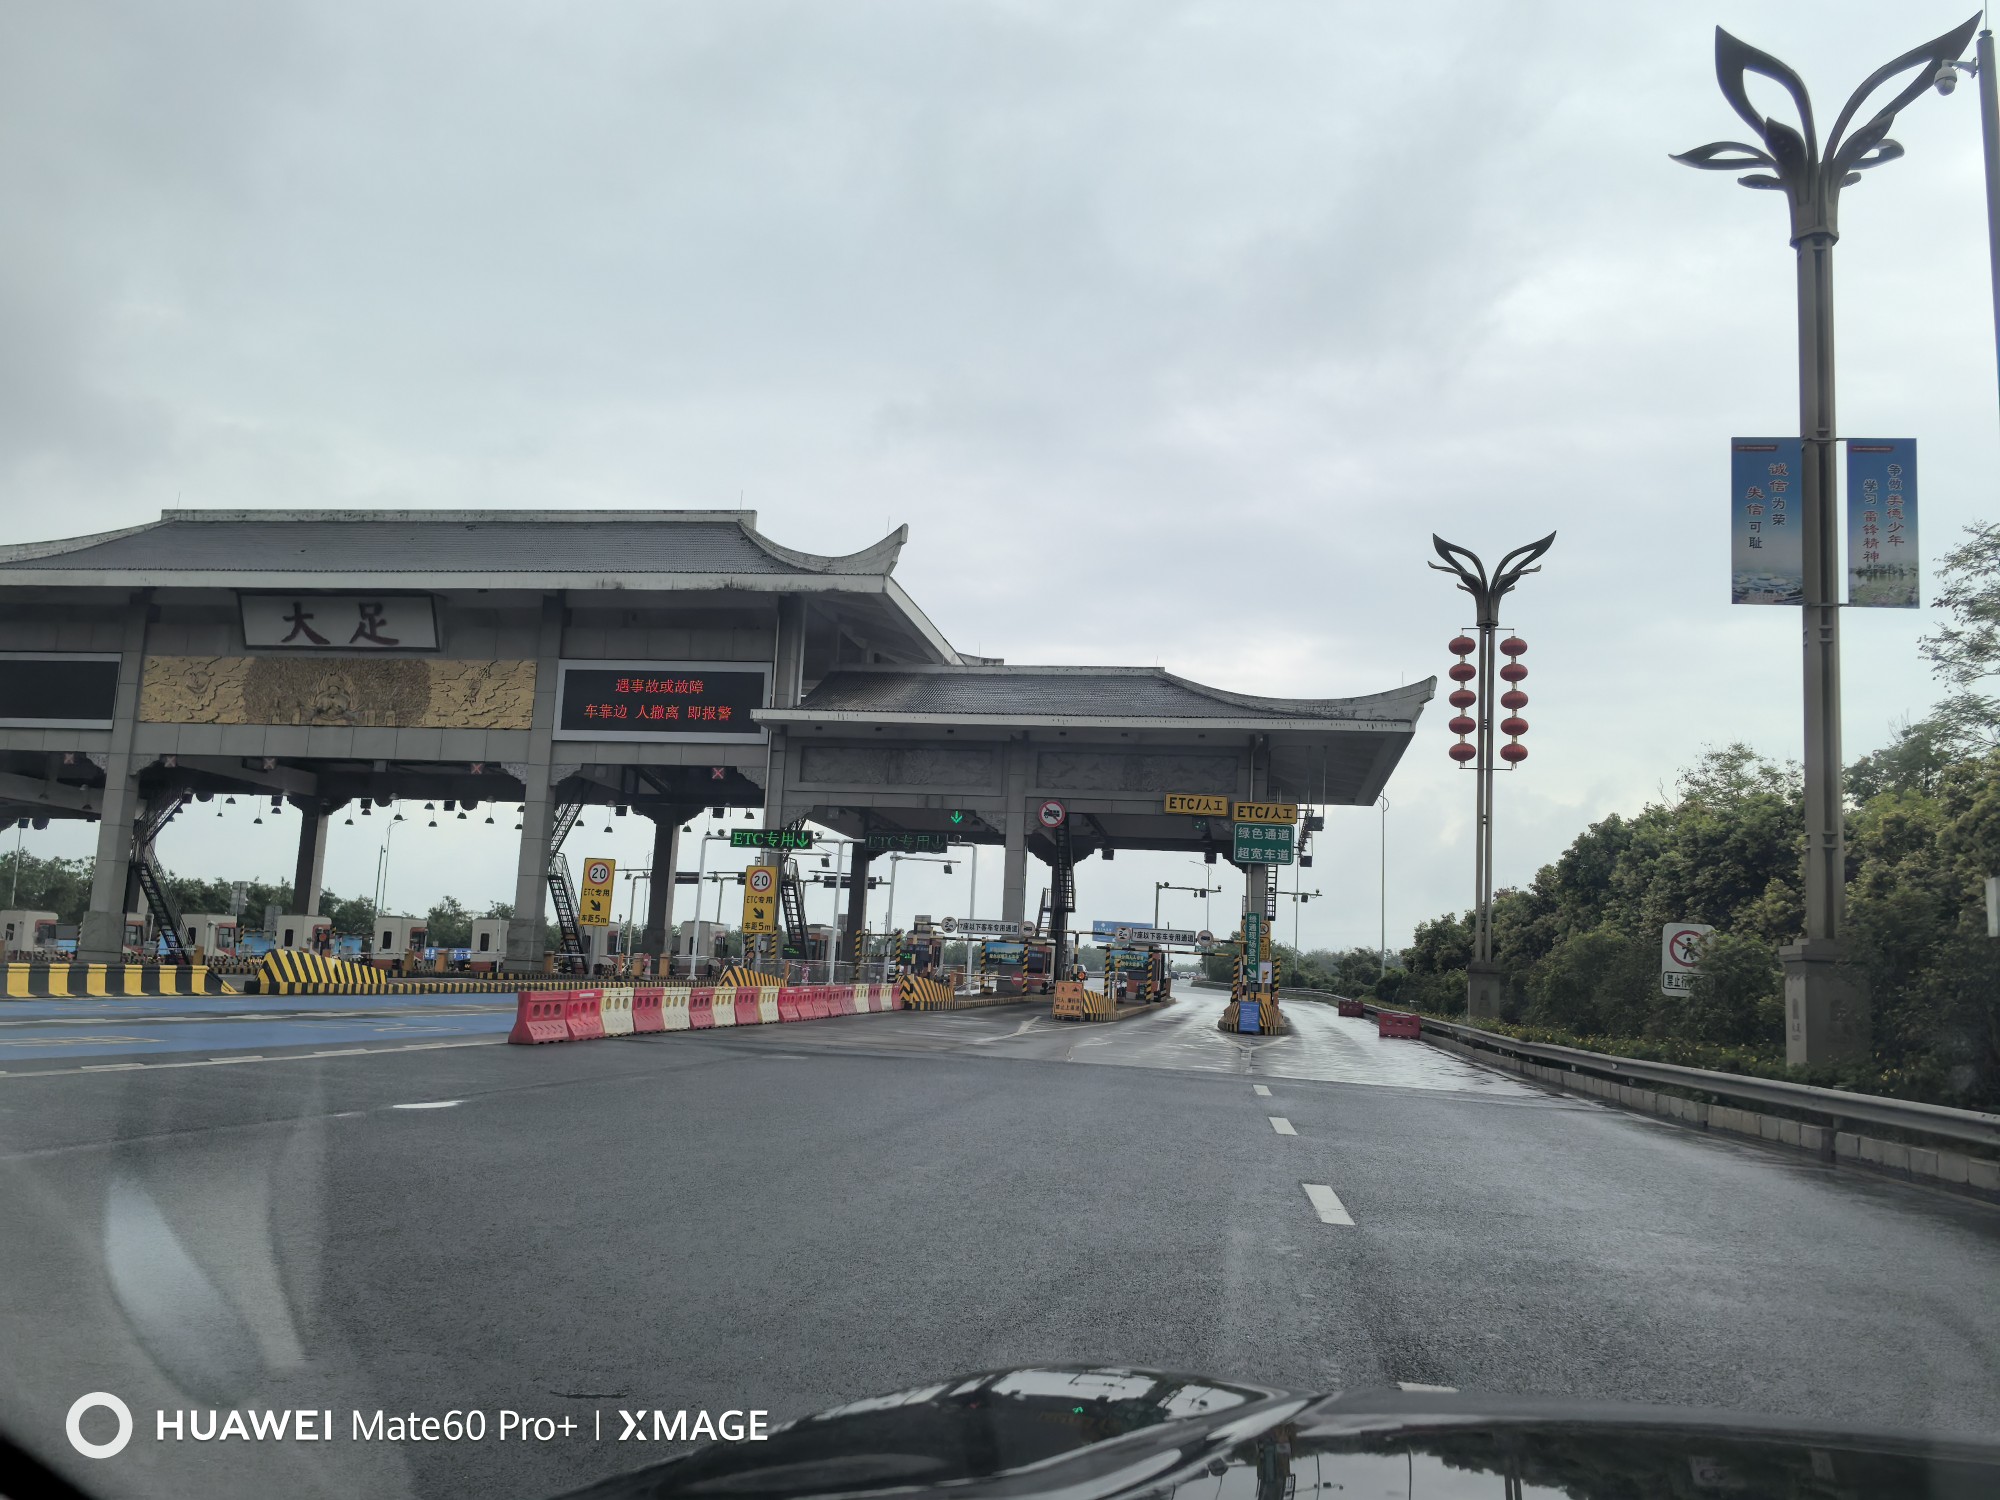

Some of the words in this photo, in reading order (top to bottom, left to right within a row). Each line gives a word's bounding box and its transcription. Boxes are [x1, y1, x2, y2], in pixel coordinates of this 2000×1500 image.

[1768, 462, 1789, 526] 诚信为荣
[1746, 485, 1765, 549] 失信可耻
[281, 601, 400, 646] 大足
[615, 678, 704, 695] 遇事故或故障
[583, 703, 628, 720] 车靠边
[635, 704, 679, 721] 人撤离
[687, 705, 732, 722] 即报警
[1169, 797, 1223, 811] ETC/人工
[1237, 805, 1293, 819] ETC/人工
[733, 831, 796, 848] ETC专用
[1237, 826, 1290, 841] 绿色通道
[1237, 846, 1290, 861] 超宽车道
[592, 867, 607, 880] 20
[754, 875, 768, 887] 20
[583, 888, 610, 897] ETC专用
[746, 896, 773, 905] ETC专用
[581, 914, 607, 924] 车距5m
[744, 922, 771, 932] 车距5m
[959, 922, 1019, 933] 7座以下客车专用通道
[1133, 930, 1194, 943] 7座以下客车专用通道
